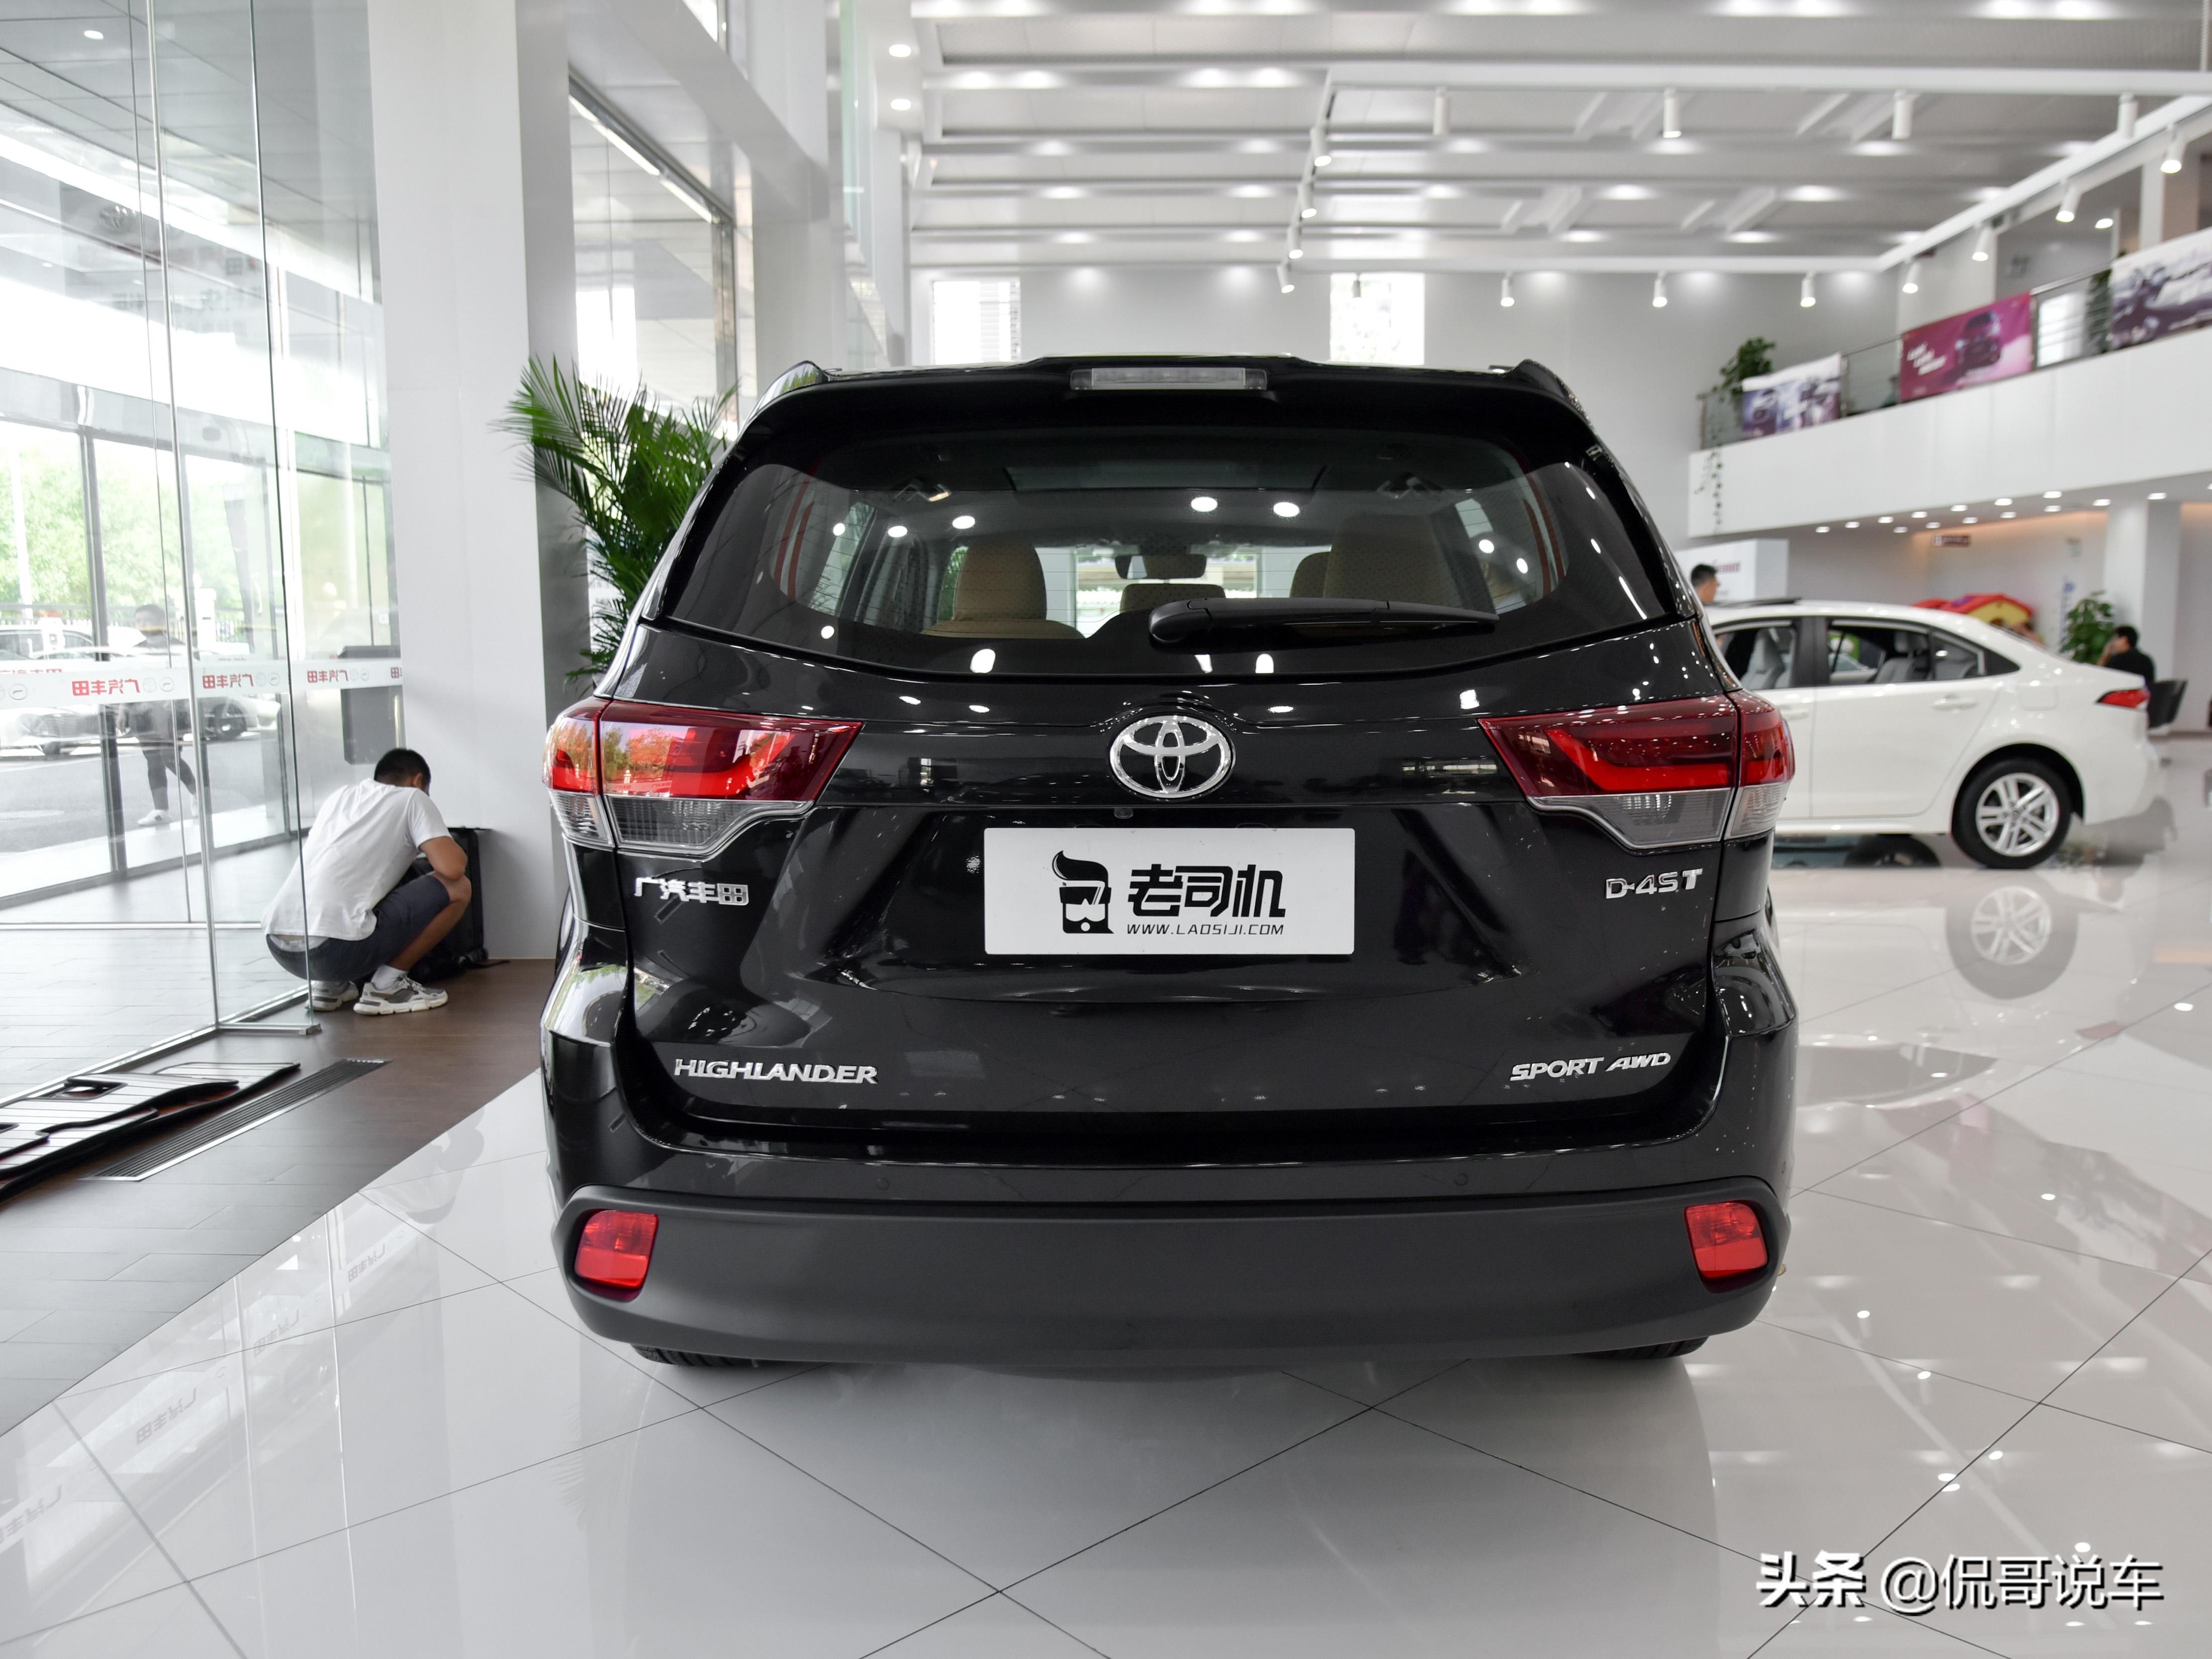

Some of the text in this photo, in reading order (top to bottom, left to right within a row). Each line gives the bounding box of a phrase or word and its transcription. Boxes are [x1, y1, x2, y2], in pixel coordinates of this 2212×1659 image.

[634, 877, 749, 905] 广汽丰田
[1128, 864, 1286, 917] 老司机
[1127, 924, 1284, 935] WWW.LAOSIJI.COM
[674, 1058, 878, 1084] HIGHLANDER
[1510, 1052, 1671, 1081] SPORT AWD
